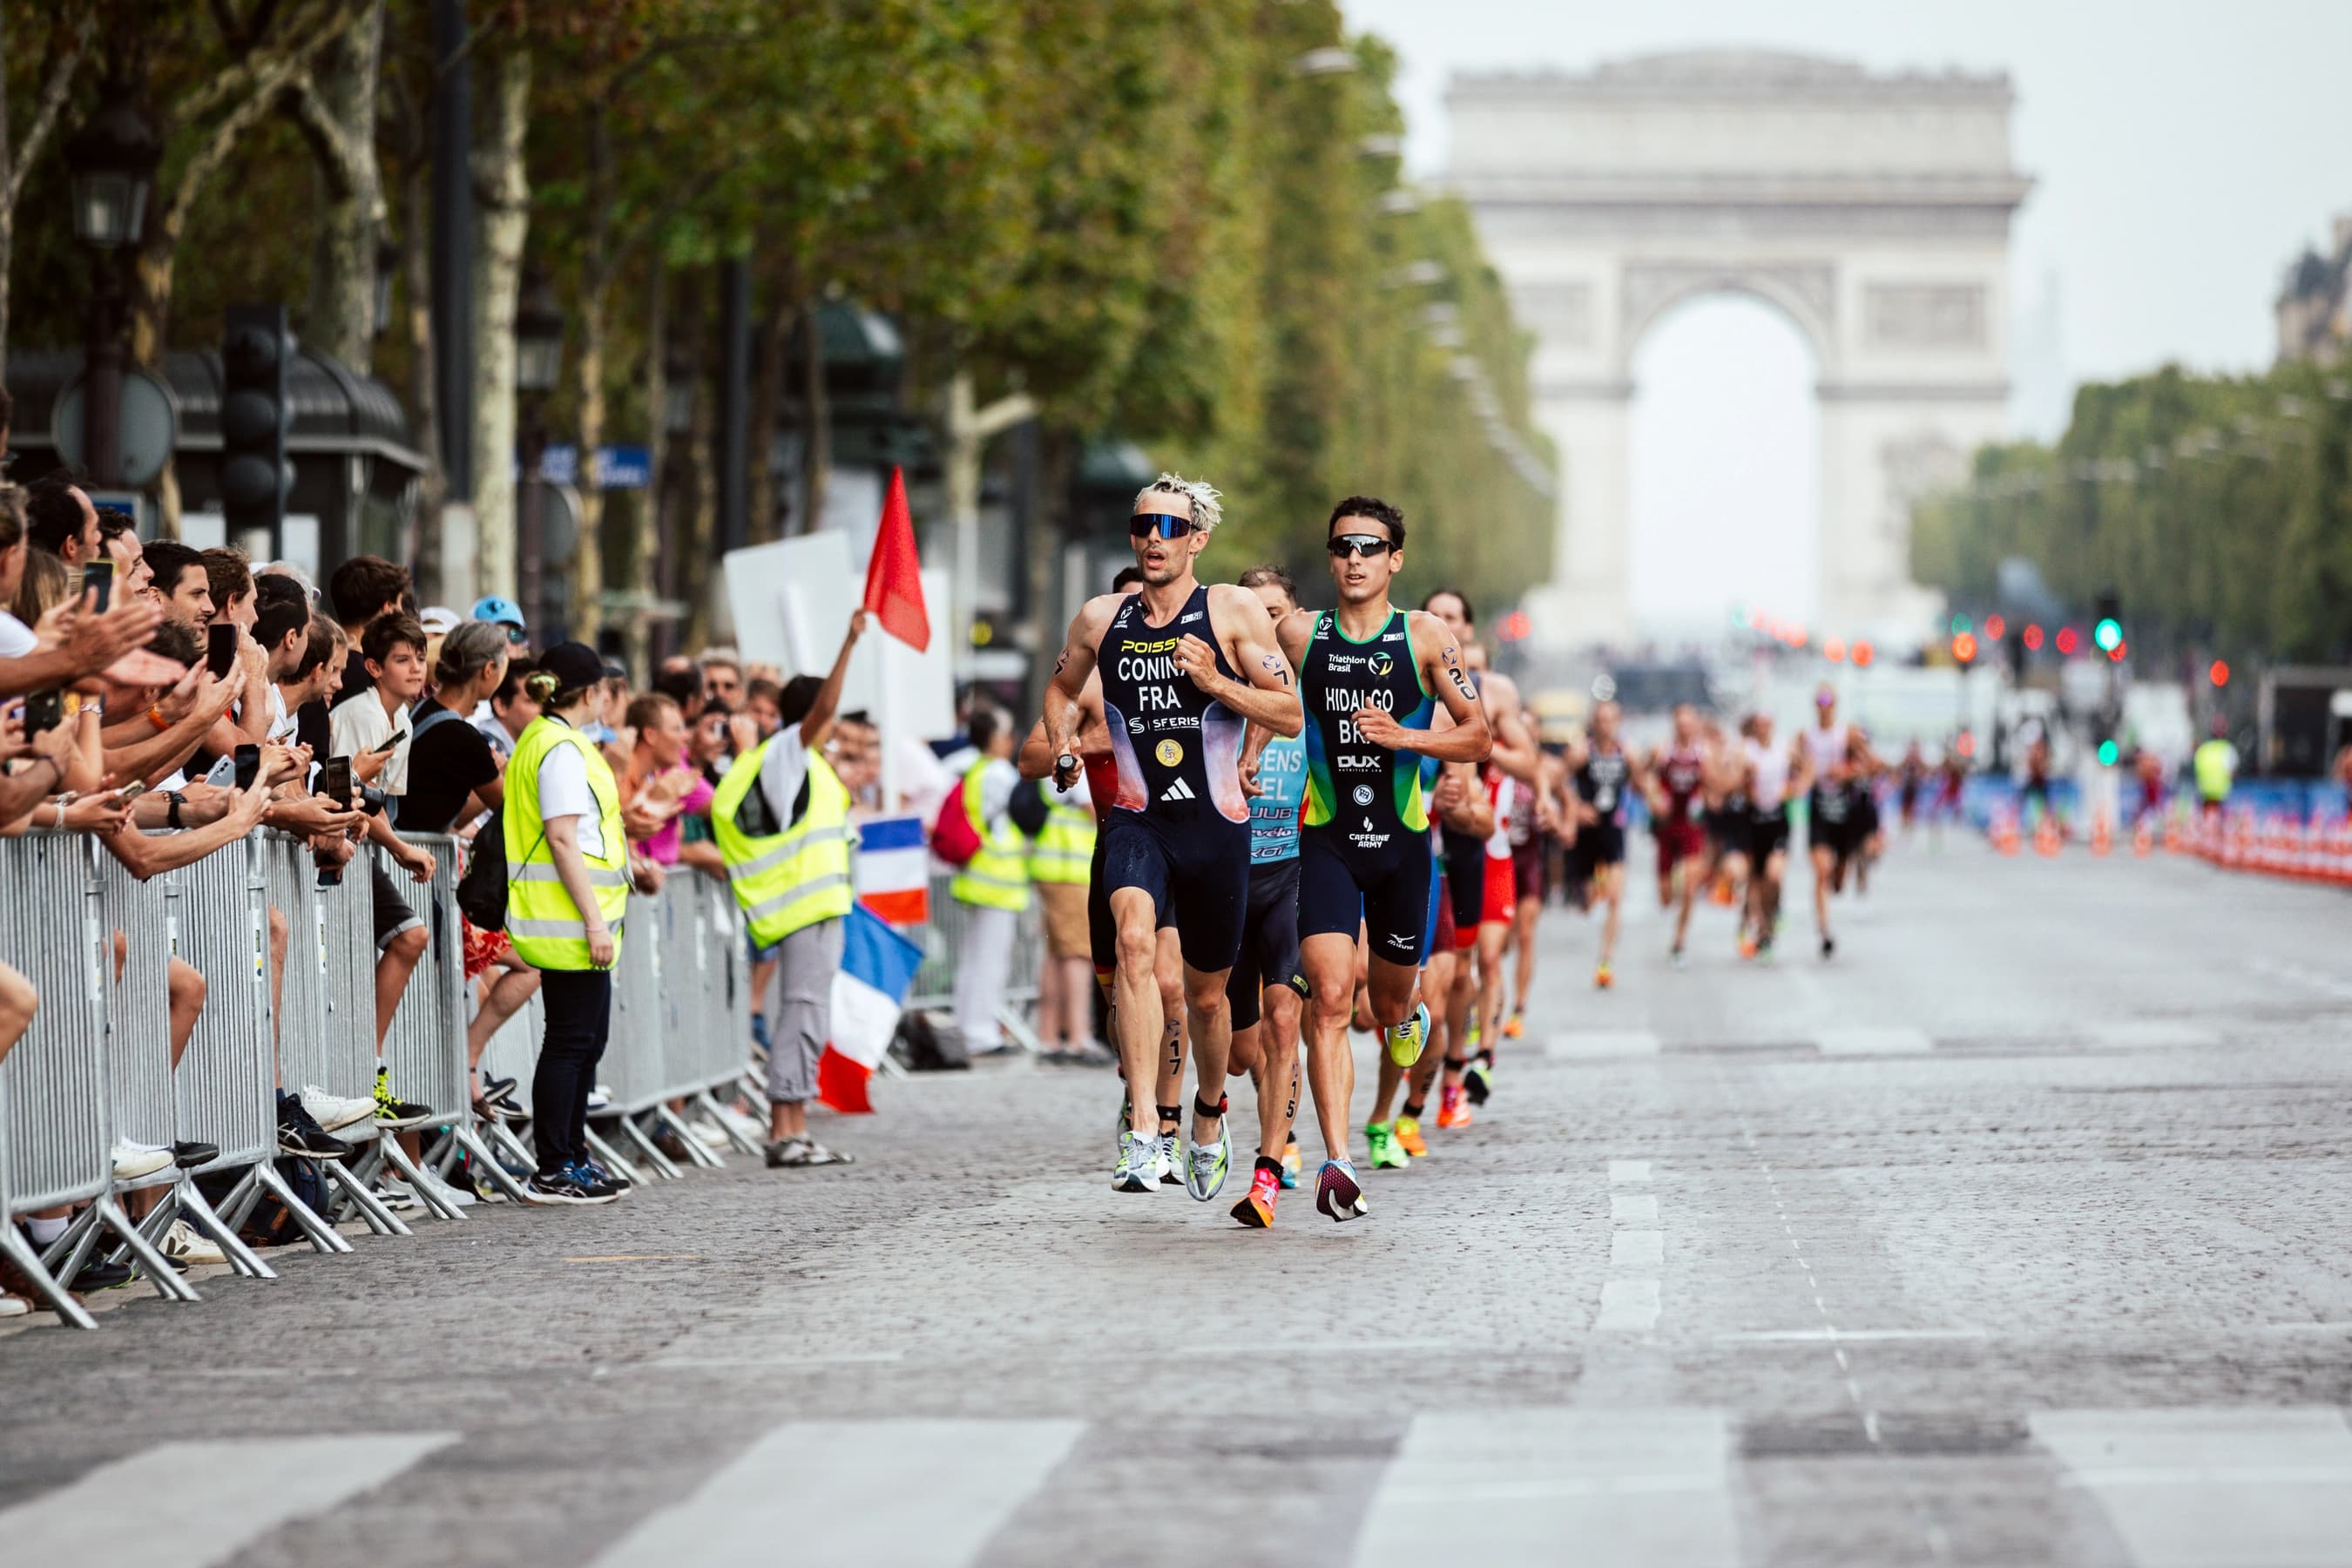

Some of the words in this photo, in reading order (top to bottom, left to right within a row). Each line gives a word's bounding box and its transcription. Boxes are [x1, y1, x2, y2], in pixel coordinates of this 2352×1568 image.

[1121, 637, 1179, 653] POISS
[1328, 653, 1366, 665] Triathlon
[1328, 663, 1351, 672] Brasil
[1274, 669, 1289, 686] 7
[1448, 667, 1476, 700] 20
[1138, 685, 1182, 712] FRA
[1325, 686, 1394, 713] HIDALGO
[1152, 716, 1200, 728] SFERIS
[1339, 720, 1371, 745] BR
[1260, 749, 1302, 773] ENS
[1337, 755, 1382, 767] DUX
[1249, 807, 1293, 820] UUB
[1251, 827, 1292, 837] vélo
[1348, 833, 1391, 842] CAFFEINE
[1168, 1039, 1181, 1075] 17
[1286, 1080, 1297, 1119] 15
